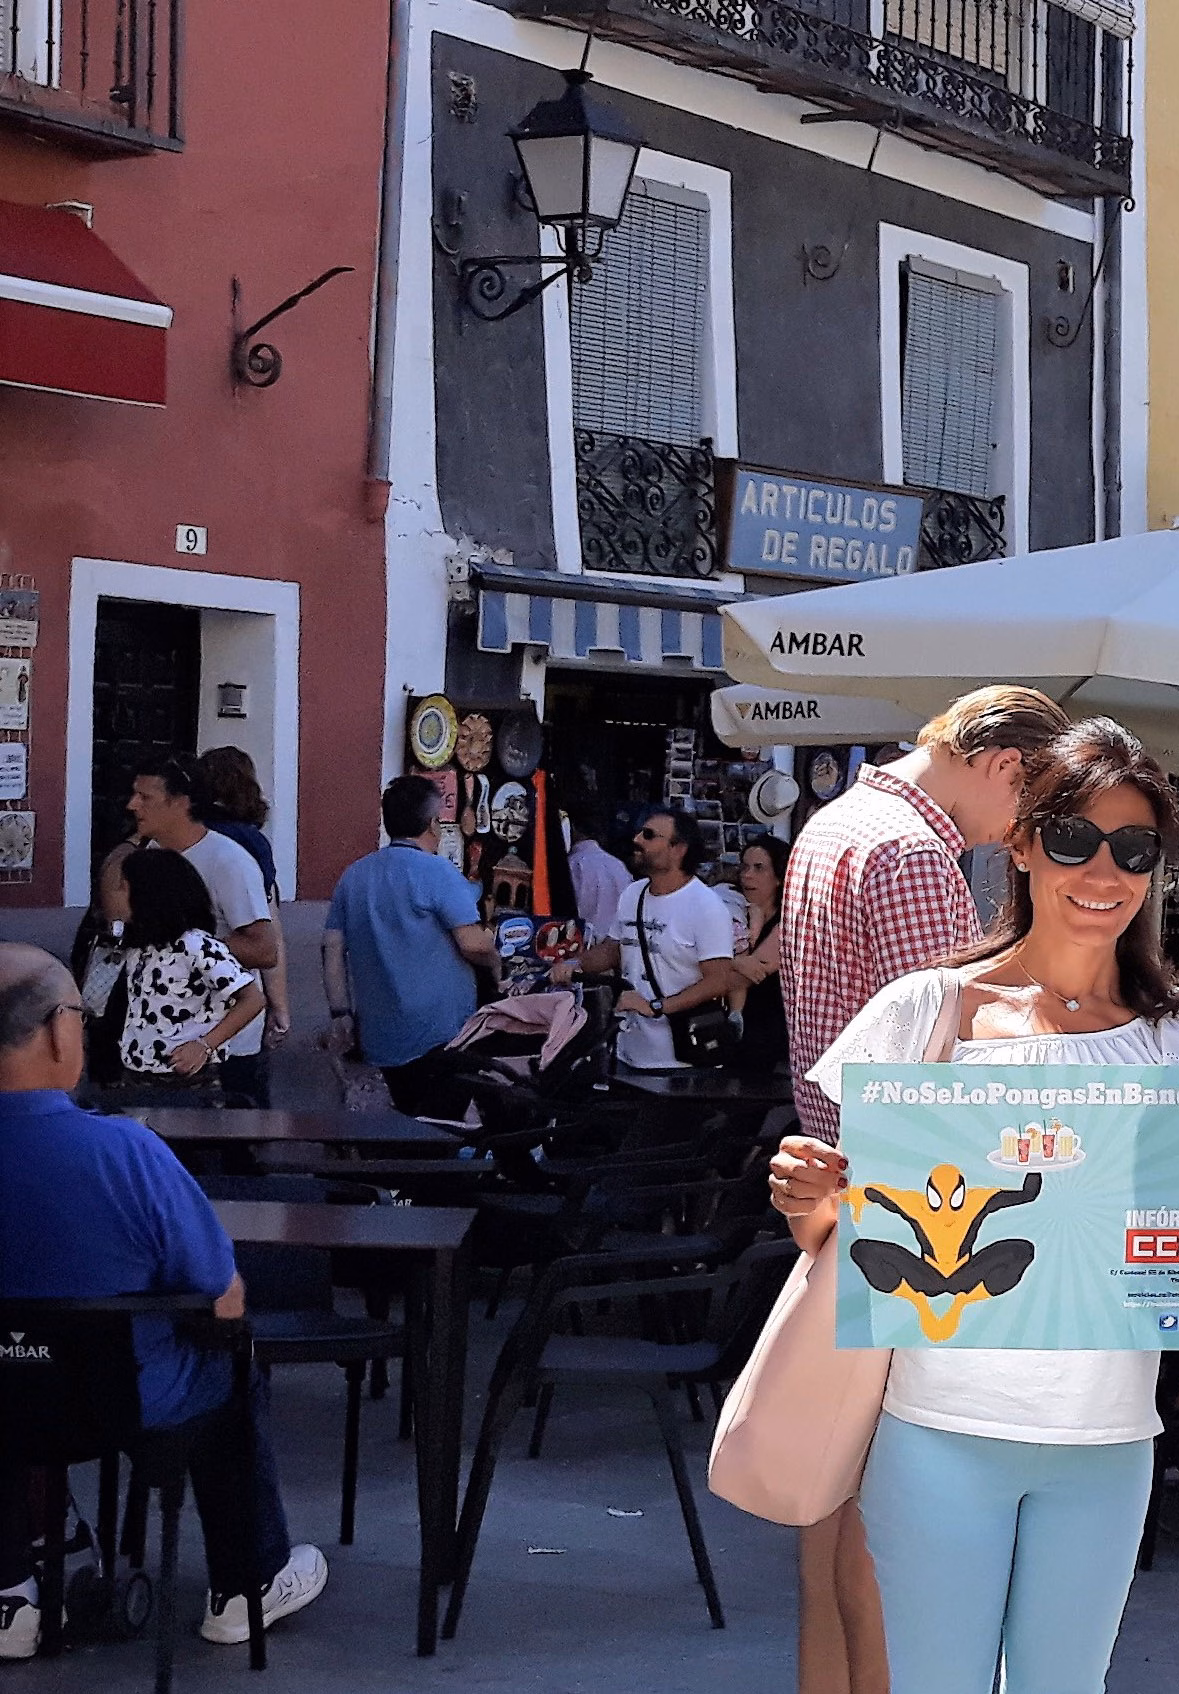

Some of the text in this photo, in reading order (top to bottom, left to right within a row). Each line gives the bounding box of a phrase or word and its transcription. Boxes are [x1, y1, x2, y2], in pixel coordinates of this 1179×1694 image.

[740, 479, 898, 533] ARTICULOS
[186, 528, 198, 551] 9
[762, 528, 914, 576] DE REGALO
[770, 631, 866, 657] AMBAR
[751, 700, 822, 721] AMBAR
[0, 1344, 51, 1359] MBAR
